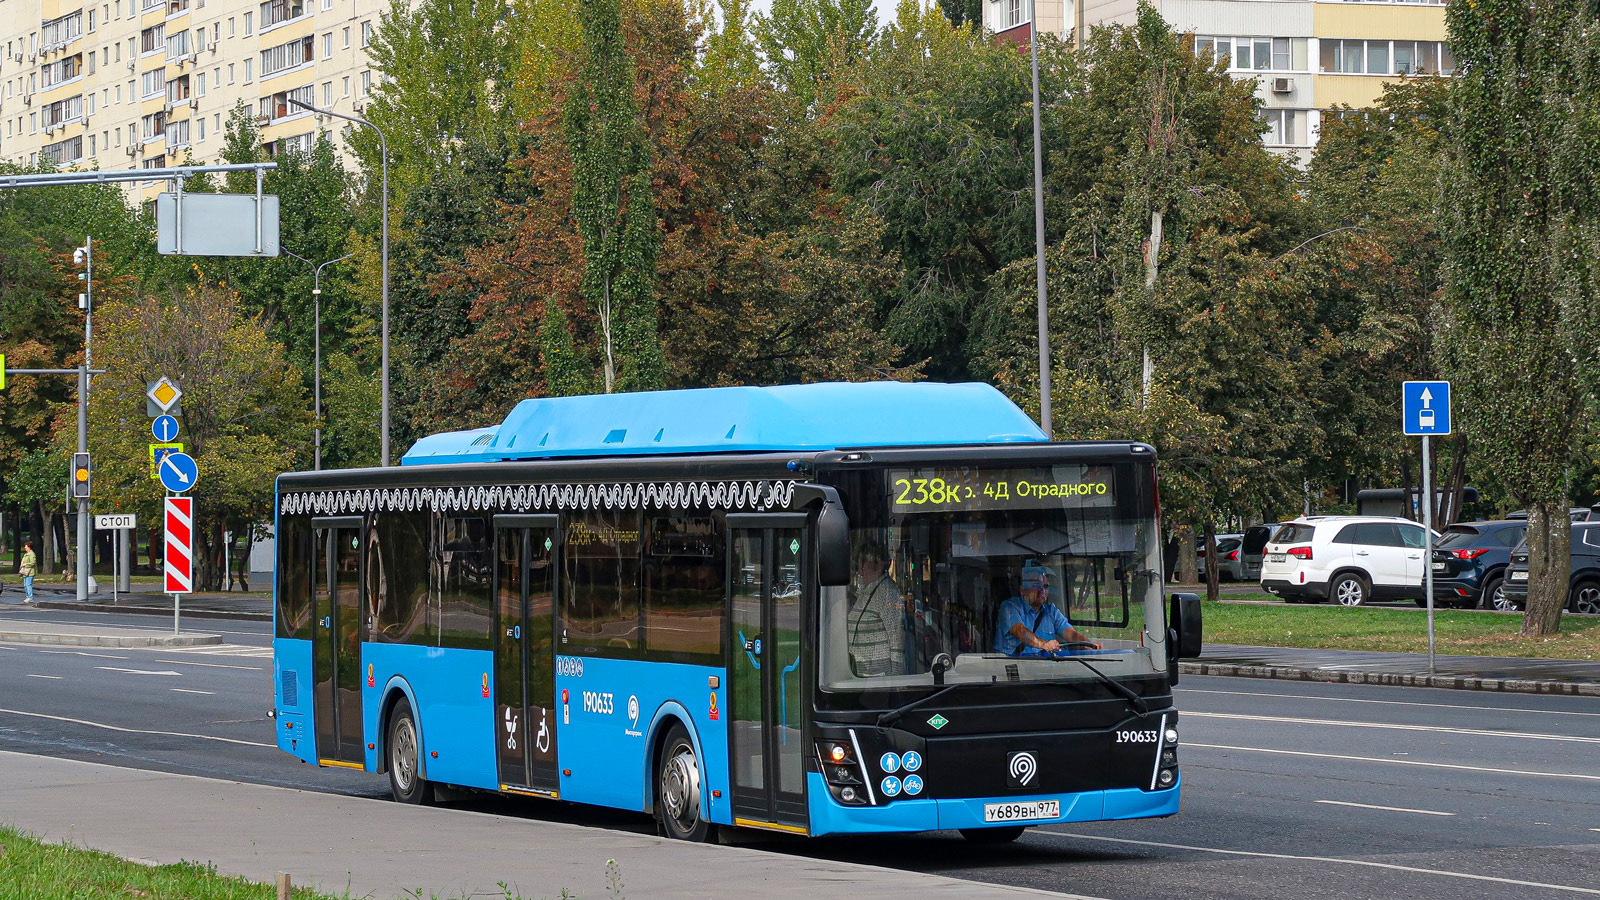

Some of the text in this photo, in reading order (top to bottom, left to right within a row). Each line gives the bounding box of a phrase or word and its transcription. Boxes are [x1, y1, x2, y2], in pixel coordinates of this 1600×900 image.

[983, 482, 1009, 500] 4Д
[1016, 481, 1107, 499] Отрадного
[101, 516, 130, 526] СТОП
[582, 691, 614, 715] 190633
[1116, 730, 1157, 743] 190633
[1038, 802, 1056, 813] 977
